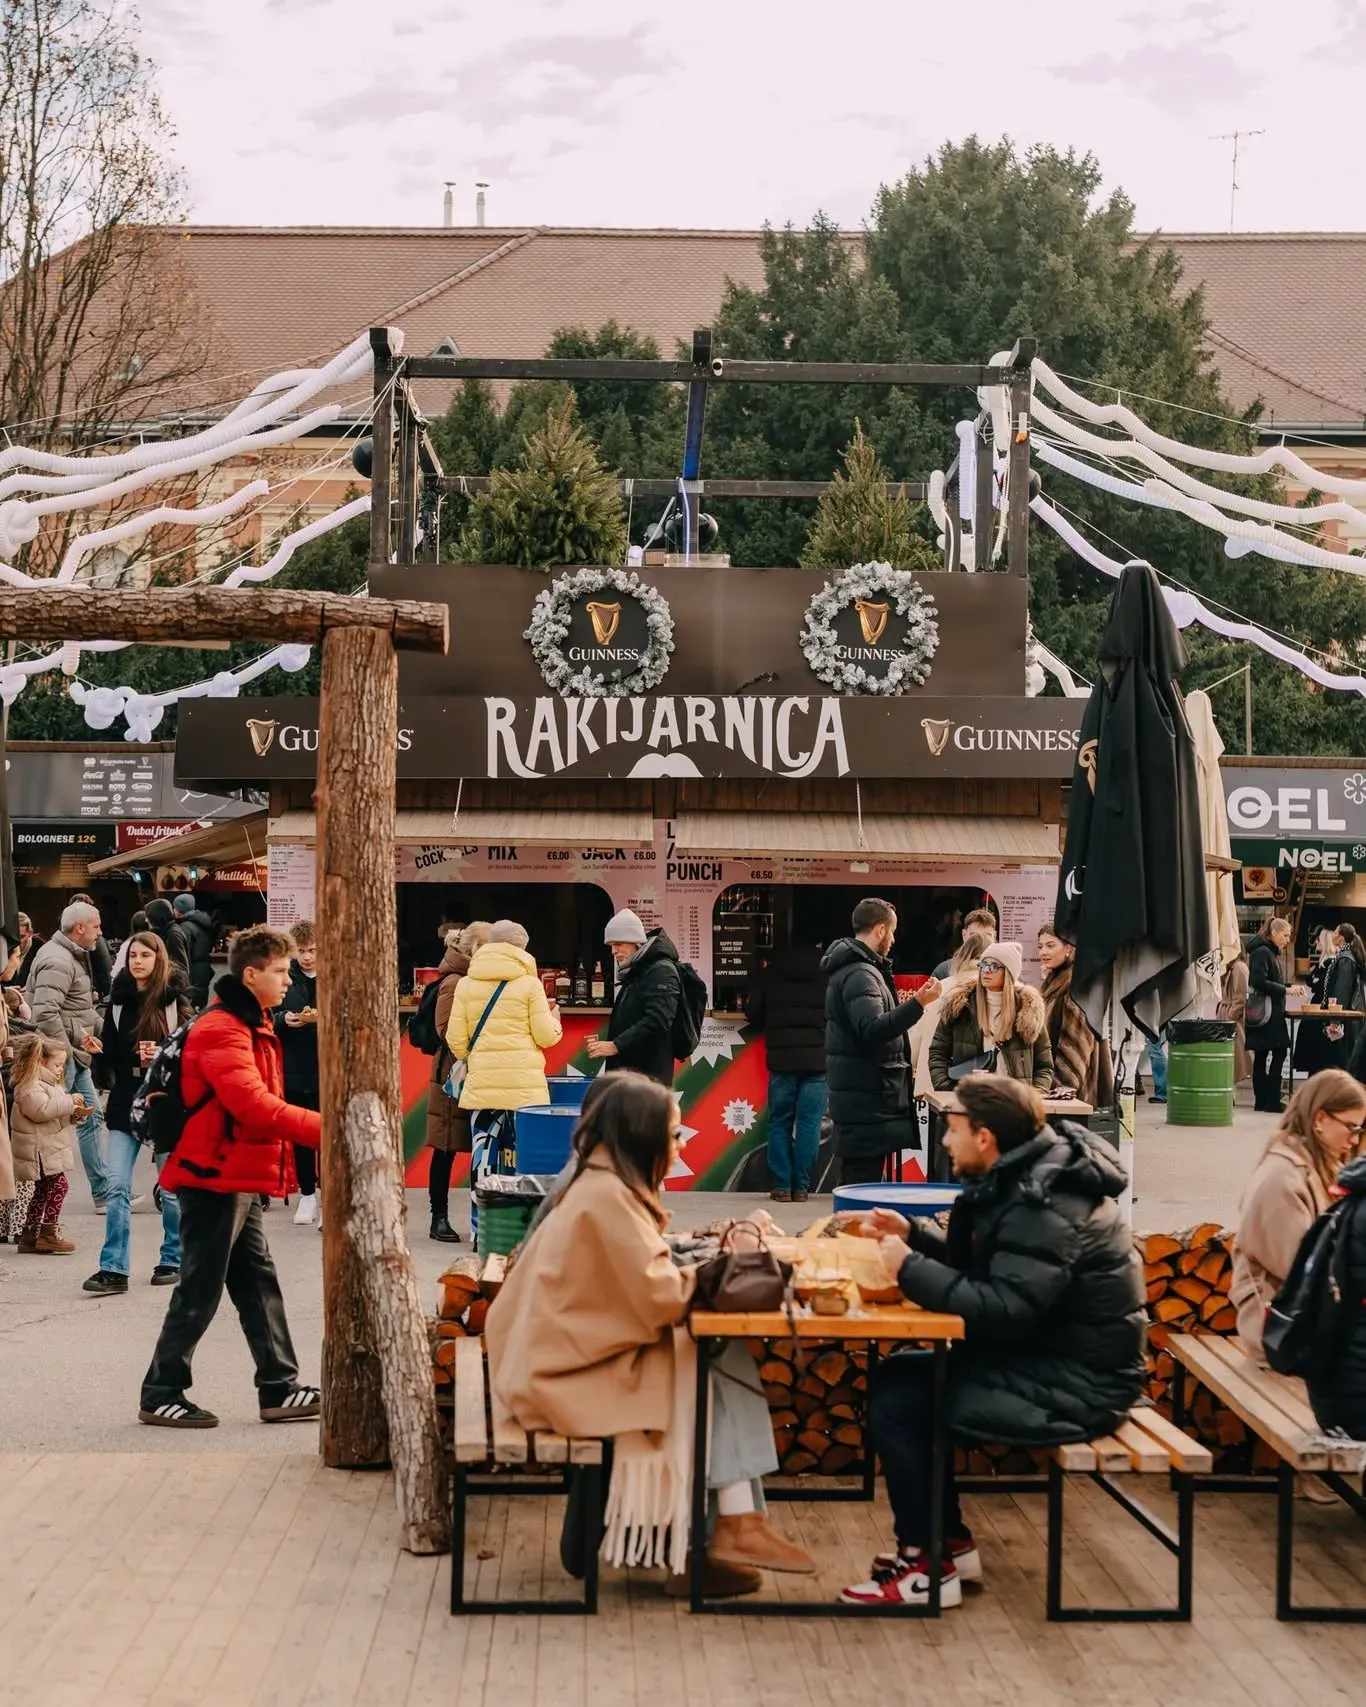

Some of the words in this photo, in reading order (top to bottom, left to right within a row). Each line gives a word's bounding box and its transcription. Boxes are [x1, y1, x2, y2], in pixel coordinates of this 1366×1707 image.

[569, 646, 640, 661] GUINNESS
[836, 645, 906, 661] GUINNESS
[484, 695, 850, 778] RAKIJARNICA
[1226, 786, 1346, 831] OEL
[126, 825, 154, 836] Dubai
[17, 834, 75, 844] BOLOGNESE
[487, 845, 518, 860] MIX
[1278, 847, 1353, 872] NOEL
[214, 870, 253, 881] Matilda
[666, 862, 723, 881] PUNCH
[707, 1025, 736, 1034] diplomat
